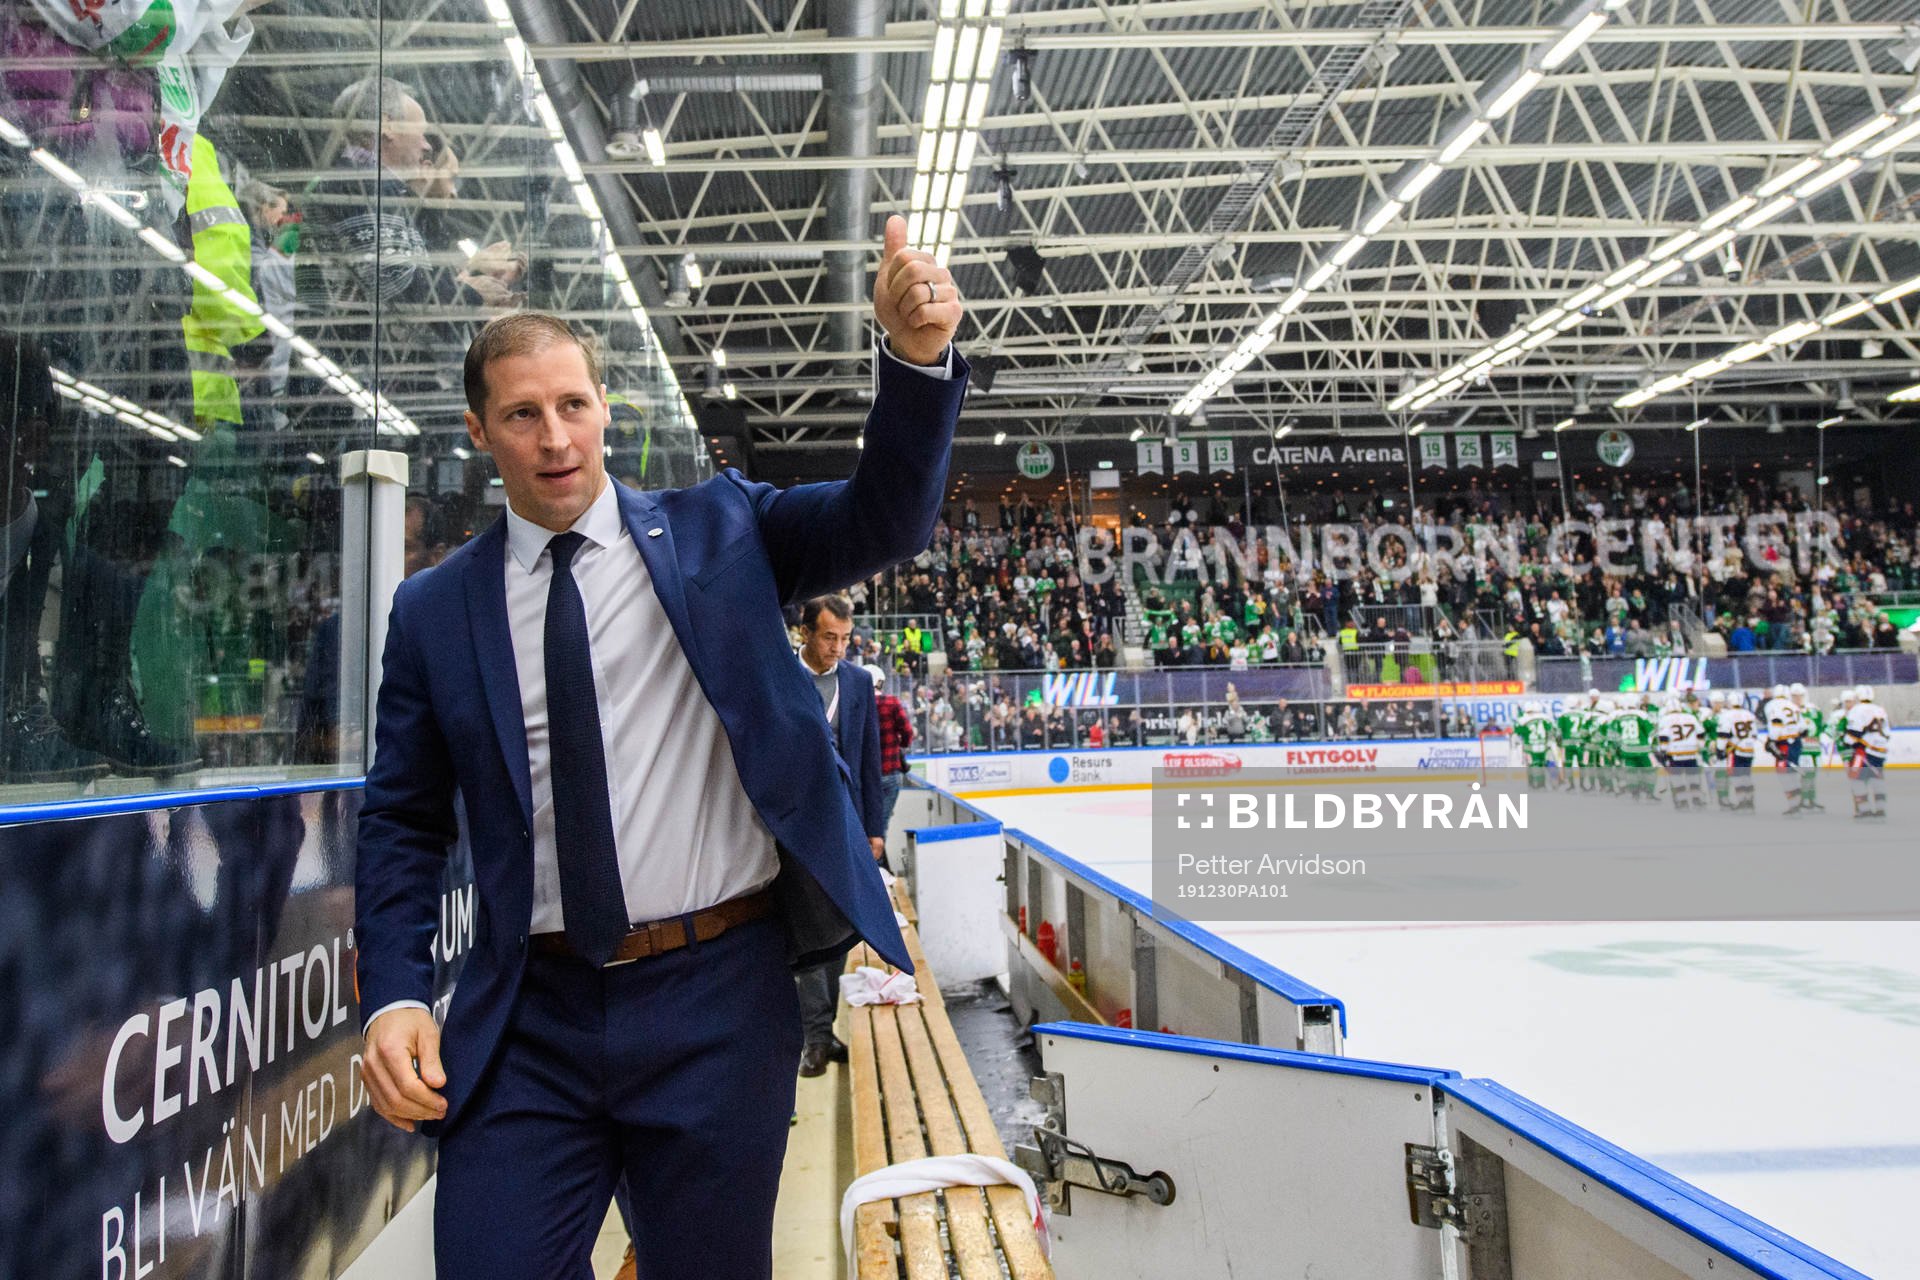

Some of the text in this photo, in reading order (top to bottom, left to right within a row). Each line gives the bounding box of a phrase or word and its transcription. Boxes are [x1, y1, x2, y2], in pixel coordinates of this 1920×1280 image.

[1146, 448, 1153, 464] 1
[1181, 448, 1190, 463] 9
[1213, 447, 1229, 462] 13
[1251, 445, 1405, 465] CATENA Arena
[1425, 442, 1441, 457] 19
[1459, 442, 1477, 457] 25
[1078, 509, 1846, 586] BRÄNNBORN CENTER
[1634, 656, 1711, 692] WILL
[1042, 671, 1120, 706] WILL
[1671, 723, 1696, 742] 37
[1072, 756, 1112, 769] Resurs
[1286, 748, 1378, 765] FLYTGOLV
[1072, 769, 1101, 783] Bank
[430, 883, 474, 962] UM
[102, 1176, 166, 1280] BLI
[183, 1113, 266, 1238] VÄN
[279, 1072, 336, 1174] MED
